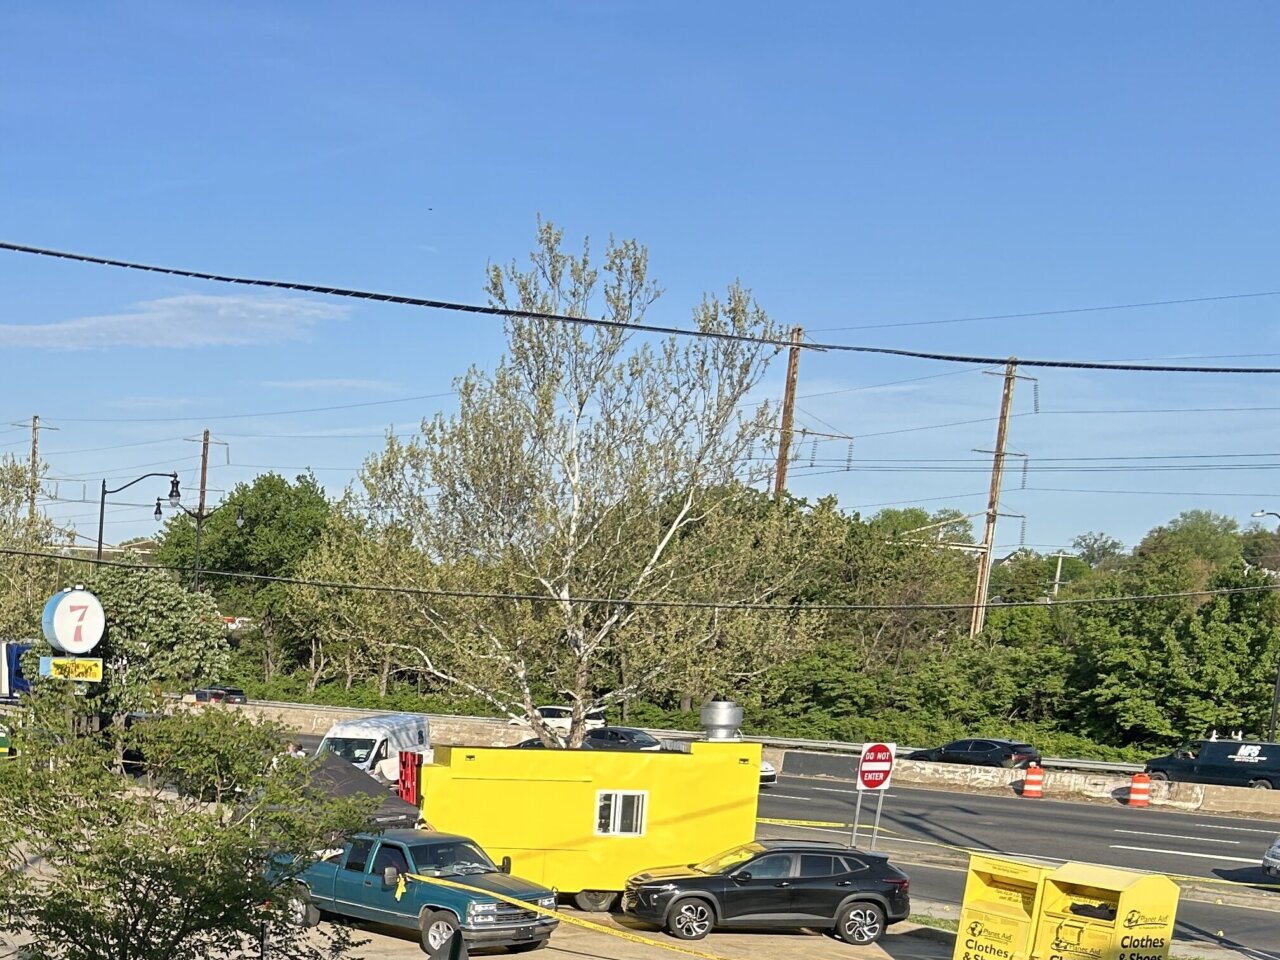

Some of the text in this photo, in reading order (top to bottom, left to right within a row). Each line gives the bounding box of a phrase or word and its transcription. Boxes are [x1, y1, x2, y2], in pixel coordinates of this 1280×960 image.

[70, 605, 89, 642] 7
[865, 752, 890, 760] DO NOT
[864, 772, 884, 780] ENTER
[965, 938, 1009, 958] Clothes
[1121, 935, 1164, 948] Clothes
